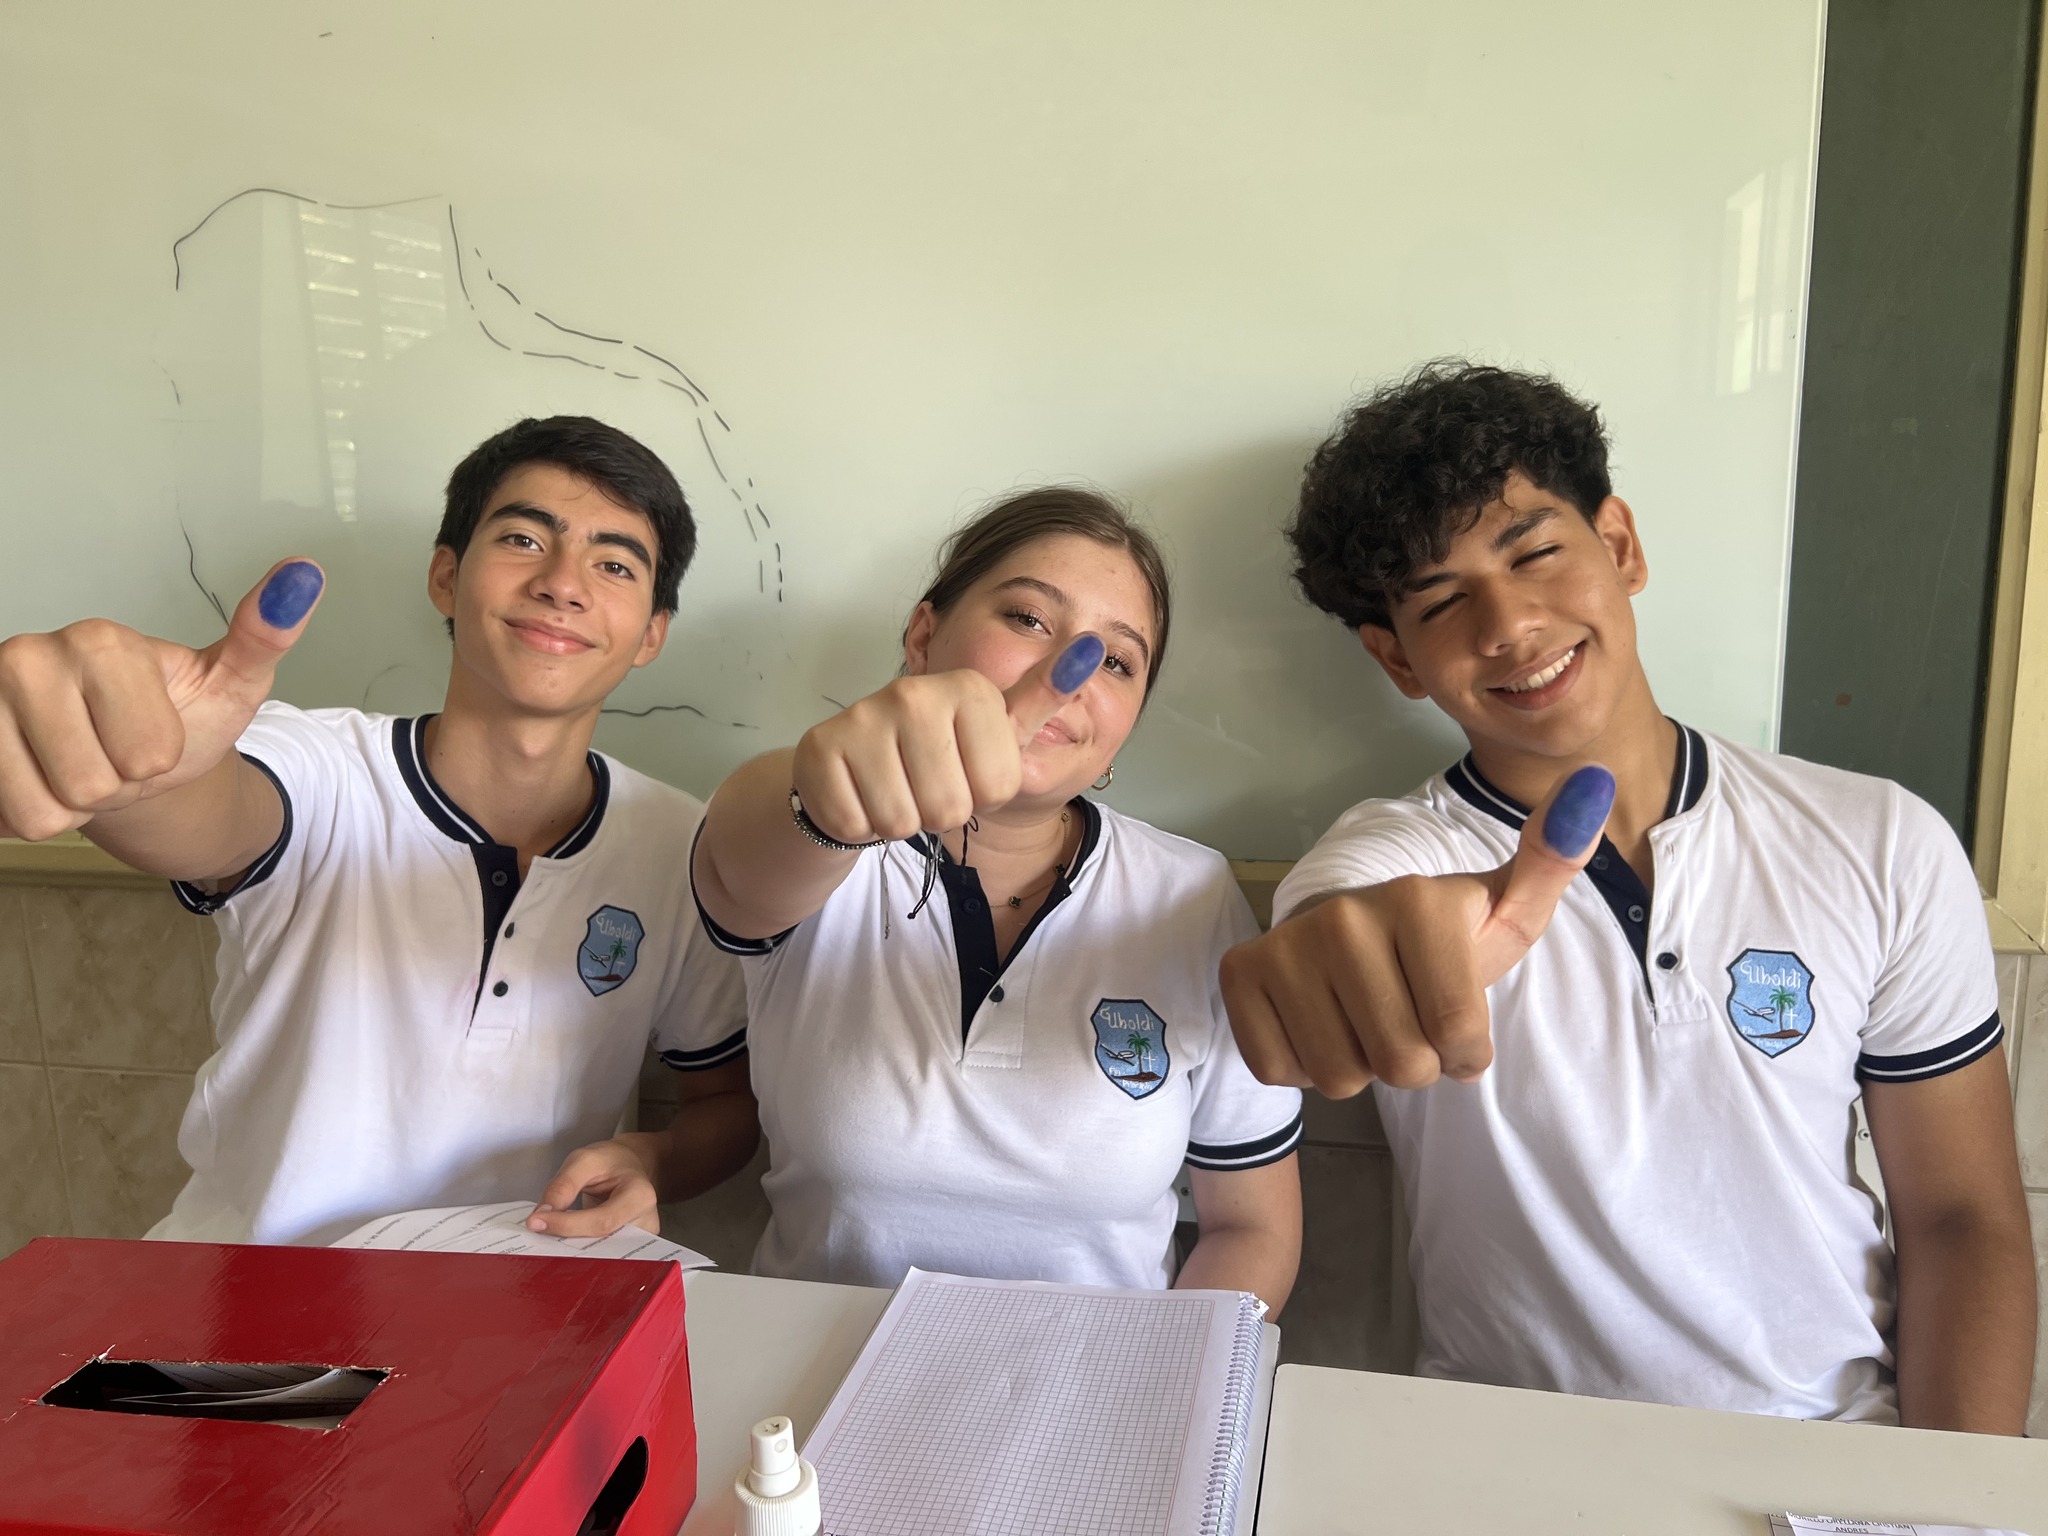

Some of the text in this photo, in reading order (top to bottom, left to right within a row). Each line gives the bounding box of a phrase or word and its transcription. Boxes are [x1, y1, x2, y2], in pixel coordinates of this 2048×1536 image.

[596, 912, 637, 942] Ubaldi
[1740, 959, 1801, 989] Ubaldi
[1100, 1006, 1155, 1031] Ubaldi
[1835, 1526, 1869, 1534] ANDRES
